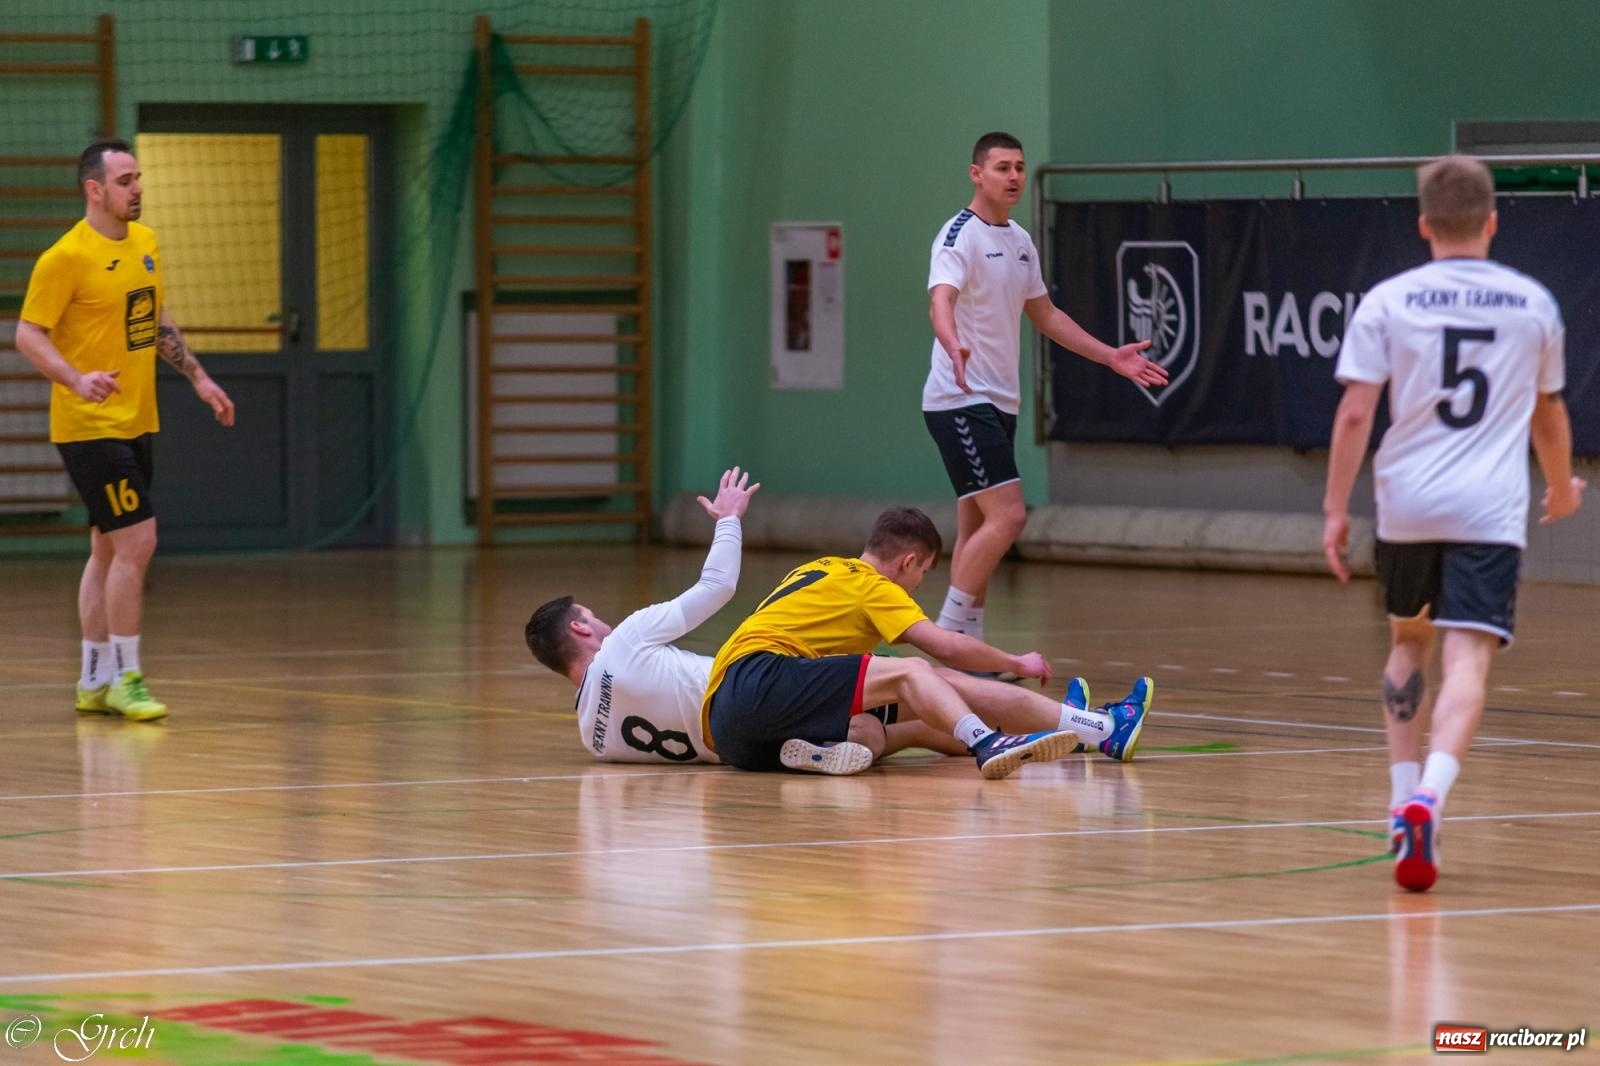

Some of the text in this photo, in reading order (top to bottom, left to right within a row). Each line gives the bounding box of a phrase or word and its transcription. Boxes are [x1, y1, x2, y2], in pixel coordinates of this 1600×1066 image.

[1243, 291, 1366, 358] RACI
[1435, 327, 1495, 429] 5
[103, 478, 140, 517] 16
[597, 668, 614, 719] TRAWNIK
[620, 715, 698, 762] 8
